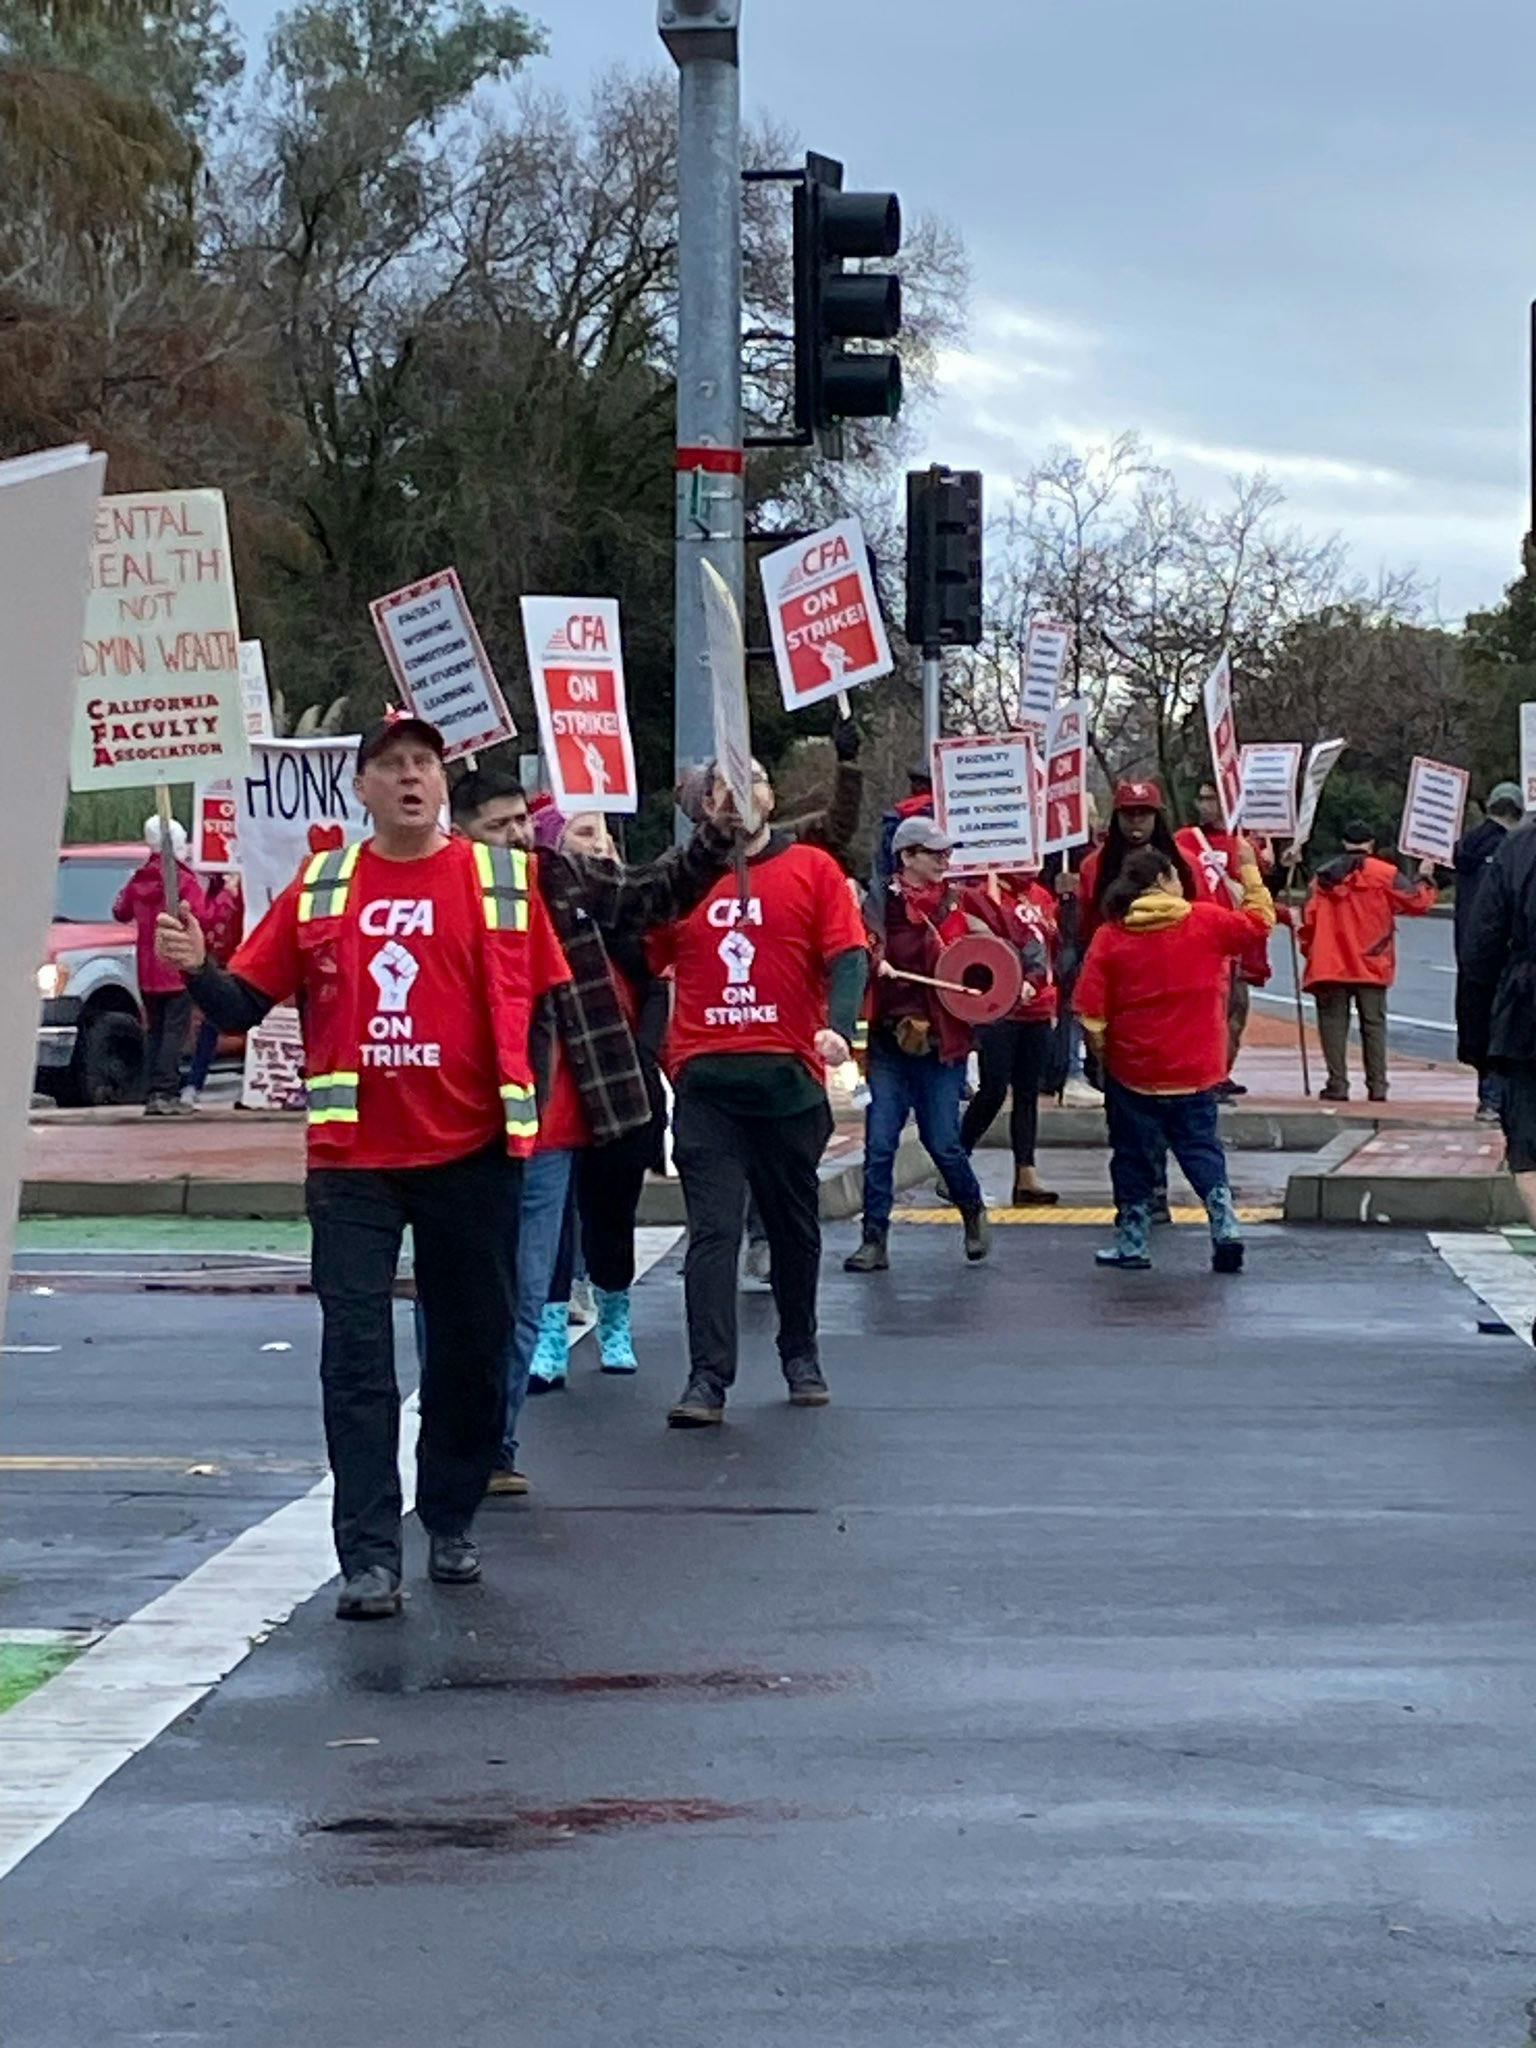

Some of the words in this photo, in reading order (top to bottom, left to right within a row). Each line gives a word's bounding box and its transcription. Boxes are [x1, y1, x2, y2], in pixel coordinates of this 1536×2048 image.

[94, 502, 204, 544] ENTAL
[90, 548, 222, 589] EALTH
[802, 535, 849, 576] CFA
[118, 591, 177, 627] NOT
[803, 584, 838, 616] ON
[566, 615, 608, 651] CFA
[786, 602, 866, 650] STRIKE!
[77, 635, 146, 677] DMIN
[156, 630, 239, 674] WEALTH
[567, 675, 599, 702] ON
[87, 694, 220, 720] CALIFORNIA
[90, 715, 219, 744] FACULTY
[93, 741, 223, 768] ASSOCIATION
[245, 751, 349, 820] HONK
[358, 898, 434, 936] CFA
[722, 985, 756, 1004] ON
[367, 1016, 412, 1039] ON
[704, 1004, 778, 1025] STRIKE
[359, 1043, 440, 1067] TRIKE
